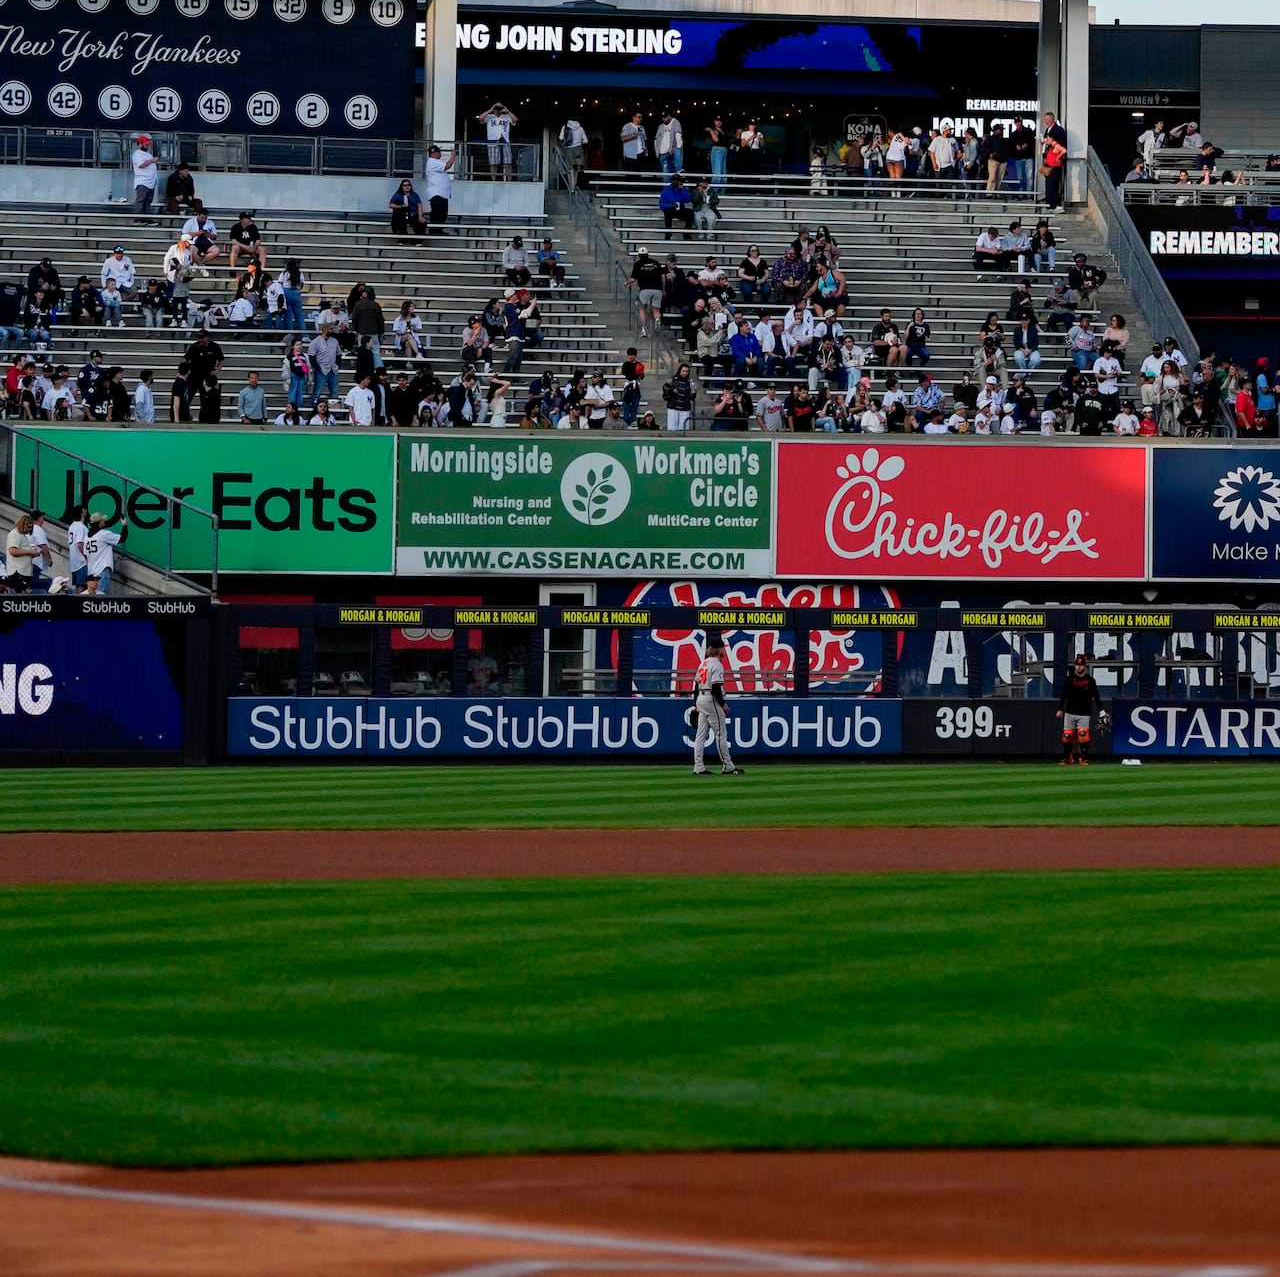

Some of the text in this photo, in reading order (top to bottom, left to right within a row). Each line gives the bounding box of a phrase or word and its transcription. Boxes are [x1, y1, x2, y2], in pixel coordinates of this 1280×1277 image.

[333, 0, 343, 16] 9
[379, 1, 396, 18] 10
[496, 25, 563, 52] JOHN
[570, 27, 682, 54] STERLING
[0, 25, 241, 76] New York Yankees
[2, 89, 25, 106] 49
[53, 92, 75, 109] 42
[110, 94, 120, 110] 6
[156, 96, 174, 113] 51
[1119, 95, 1154, 105] WOMEN
[203, 98, 225, 115] 46
[253, 100, 274, 117] 20
[307, 102, 317, 118] 2
[352, 104, 370, 120] 21
[847, 124, 882, 134] KONA
[410, 443, 553, 481] Morningside
[634, 444, 760, 475] Workmen's
[690, 478, 758, 508] Circle
[212, 472, 378, 532] Eats
[473, 496, 552, 511] Nursing and
[411, 512, 552, 526] Rehabilitation Center
[648, 514, 758, 528] MultiCare Center
[825, 472, 1100, 569] Chick-fil-A
[1212, 542, 1268, 561] Make
[423, 550, 746, 571] WWW.CASSENACARE.COM
[2, 601, 52, 614] StubHub
[82, 601, 131, 614] StubHub
[147, 601, 196, 614] StubHub
[340, 609, 421, 623] MORGAN & MORGAN
[456, 611, 536, 624] MORGAN & MORGAN
[563, 611, 648, 624] MORGAN & MORGAN
[700, 612, 783, 625] MORGAN & MORGAN
[833, 613, 916, 626] MORGAN & MORGAN
[962, 613, 1044, 626] MORGAN & MORGAN
[1089, 614, 1171, 626] MORGAN & MORGAN
[1215, 614, 1251, 627] MORGAN
[1253, 614, 1260, 627] &
[250, 704, 442, 750] StubHub
[463, 704, 660, 750] StubHub
[935, 705, 1012, 739] 399 FT
